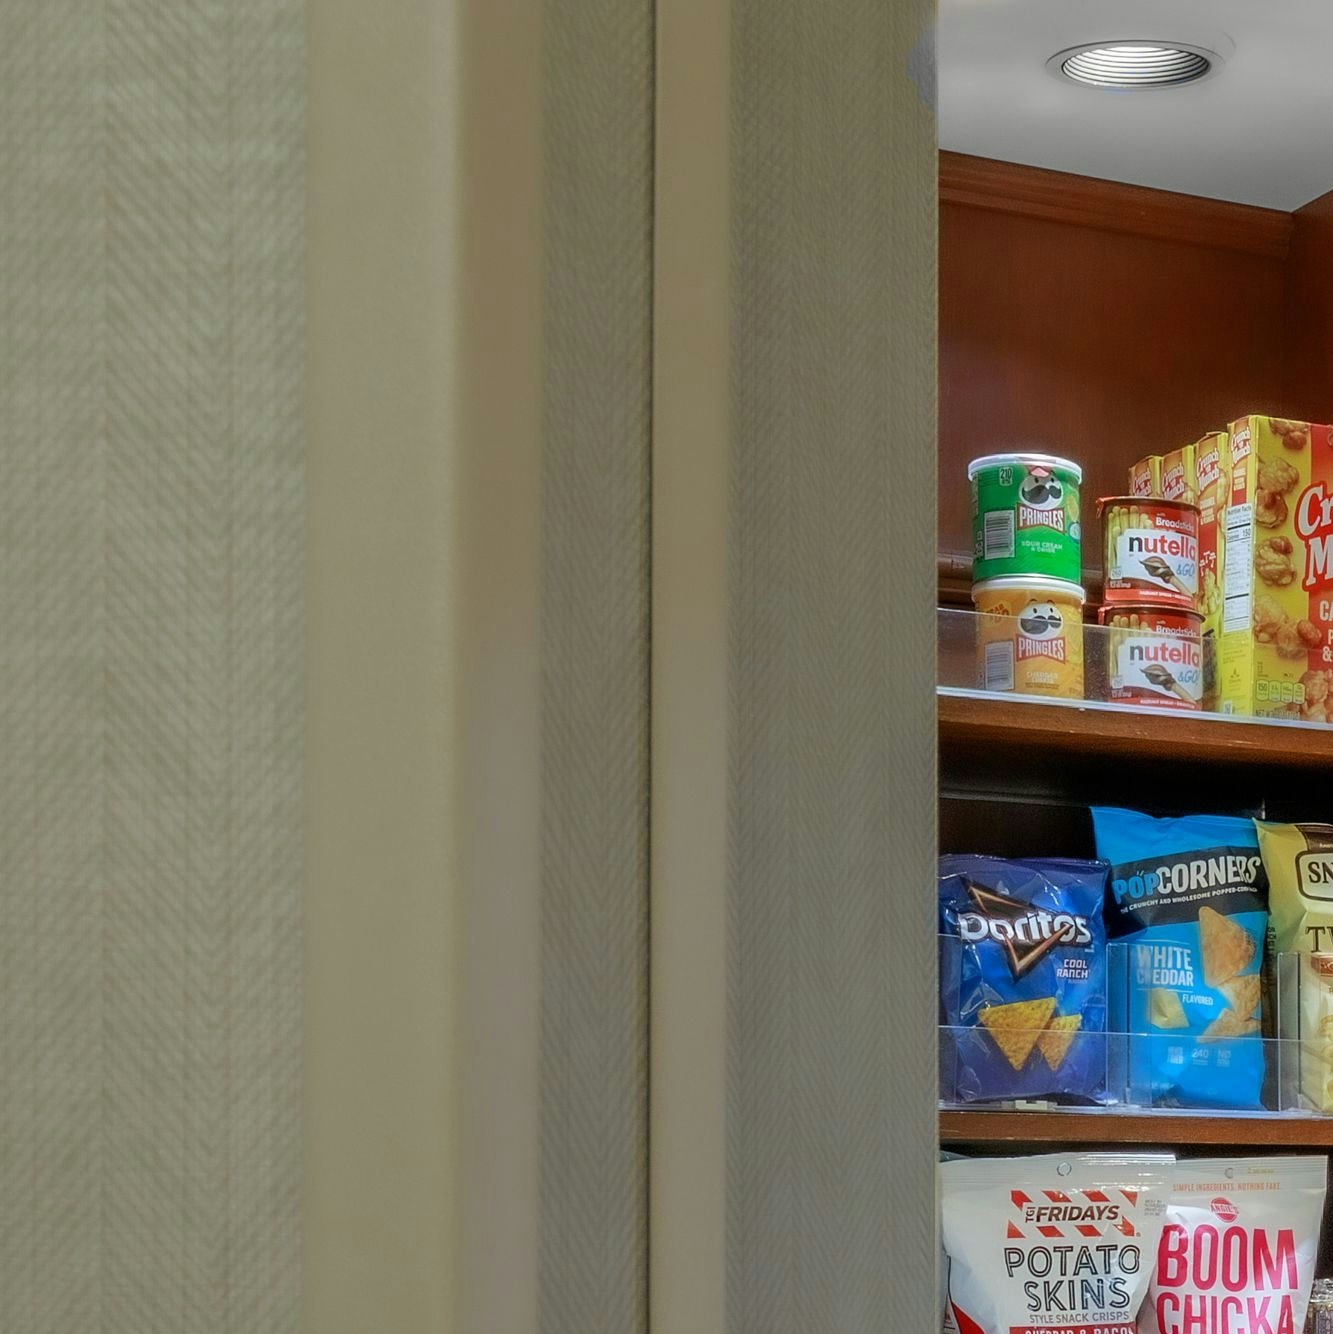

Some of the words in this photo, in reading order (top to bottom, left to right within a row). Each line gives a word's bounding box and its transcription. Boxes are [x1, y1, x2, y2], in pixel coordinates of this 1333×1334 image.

[1019, 506, 1064, 533] PRINGLES
[1018, 637, 1065, 662] PRINGLES
[1322, 647, 1333, 663] &
[957, 911, 1092, 946] Doritos
[1063, 958, 1088, 970] COOL
[1136, 946, 1193, 971] WHITE
[1056, 967, 1089, 980] RANCH
[1182, 993, 1214, 1007] FLAVORED
[1025, 1206, 1035, 1223] TGI
[1036, 1204, 1121, 1223] FRIDAYS
[1003, 1243, 1142, 1278] POTATO
[1156, 1224, 1299, 1293] BOOM
[1023, 1277, 1132, 1312] SKINS
[1029, 1313, 1055, 1324] STYLE
[1056, 1312, 1090, 1323] SNACK
[1091, 1310, 1130, 1322] CRISPS
